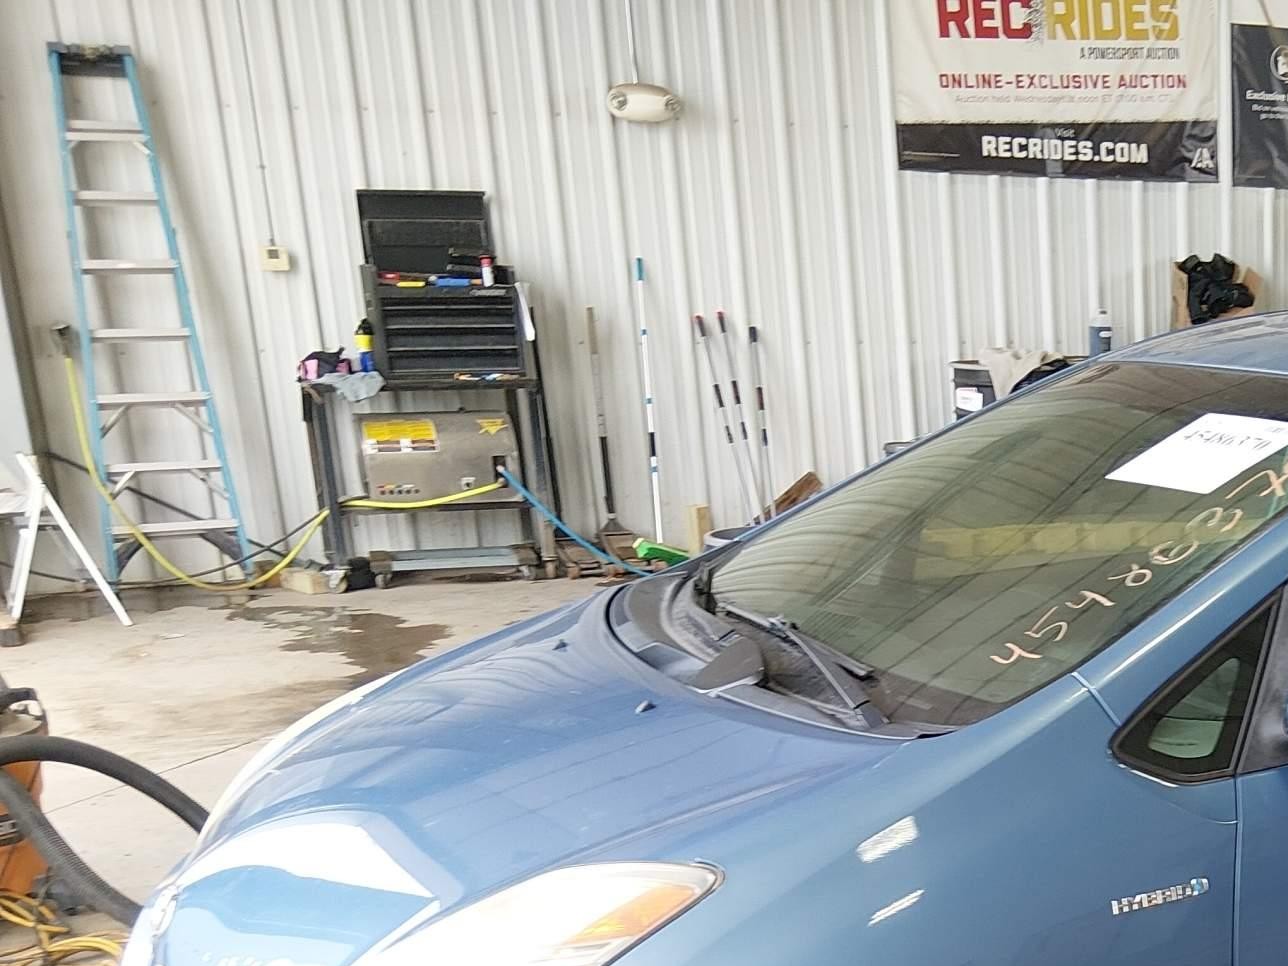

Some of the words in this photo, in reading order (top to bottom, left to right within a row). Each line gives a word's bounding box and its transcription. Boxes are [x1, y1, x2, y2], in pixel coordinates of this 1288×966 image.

[1088, 48, 1145, 60] POWERSPORT
[939, 73, 1112, 90] ONLINE-EXCLUSIVE
[1118, 74, 1187, 90] AUCTION
[981, 135, 1149, 164] RECRIDES.COM
